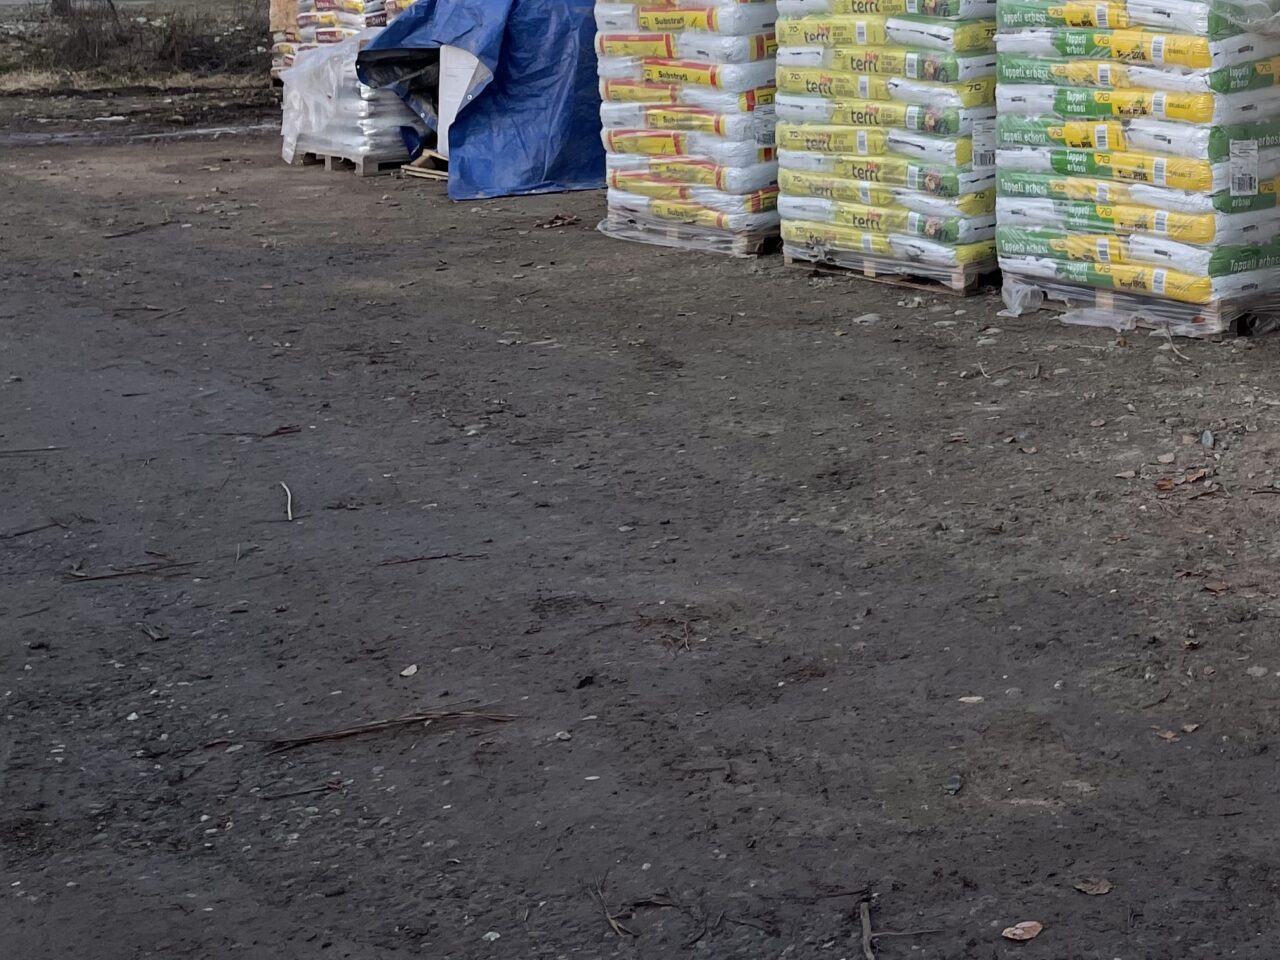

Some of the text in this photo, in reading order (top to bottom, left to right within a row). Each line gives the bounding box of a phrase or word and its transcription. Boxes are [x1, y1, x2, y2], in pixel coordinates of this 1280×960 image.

[1024, 10, 1046, 23] erbosi
[1065, 33, 1087, 45] Tappeti
[1066, 45, 1086, 55] erbosi
[850, 55, 879, 73] terri
[1002, 65, 1025, 78] Tappeti
[806, 78, 834, 96] terri
[1066, 90, 1088, 102] Tappeti
[1067, 103, 1086, 113] erbosi
[851, 111, 880, 125] terri
[1024, 130, 1046, 141] erbosi
[1258, 135, 1280, 146] erbosi
[852, 164, 881, 183] terri
[1067, 163, 1087, 173] erbosi
[852, 214, 882, 231] terri
